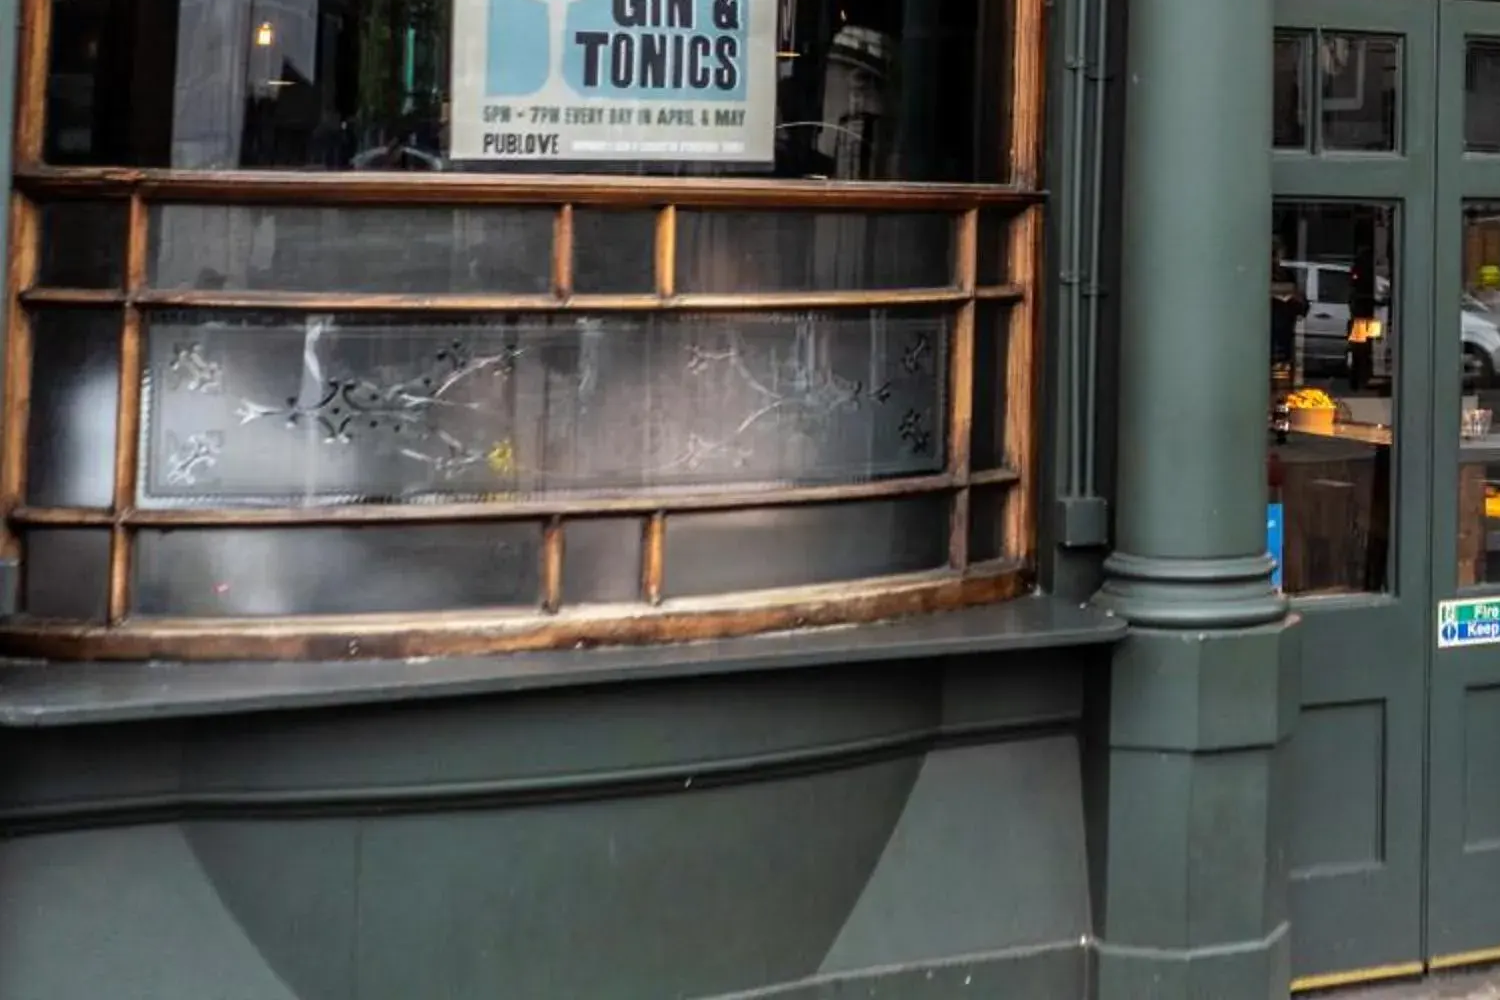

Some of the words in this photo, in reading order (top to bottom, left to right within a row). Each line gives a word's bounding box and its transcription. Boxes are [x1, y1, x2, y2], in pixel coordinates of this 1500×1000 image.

[575, 31, 739, 90] TONICS
[483, 105, 511, 123] 5PM
[530, 106, 561, 124] 7PM
[565, 107, 604, 125] EVERY
[609, 107, 633, 125] DAY
[657, 108, 694, 126] APRIL
[715, 109, 746, 127] MAY
[483, 133, 560, 154] PUBLOVE
[1474, 604, 1500, 619] Fire
[1467, 621, 1500, 638] Keep
